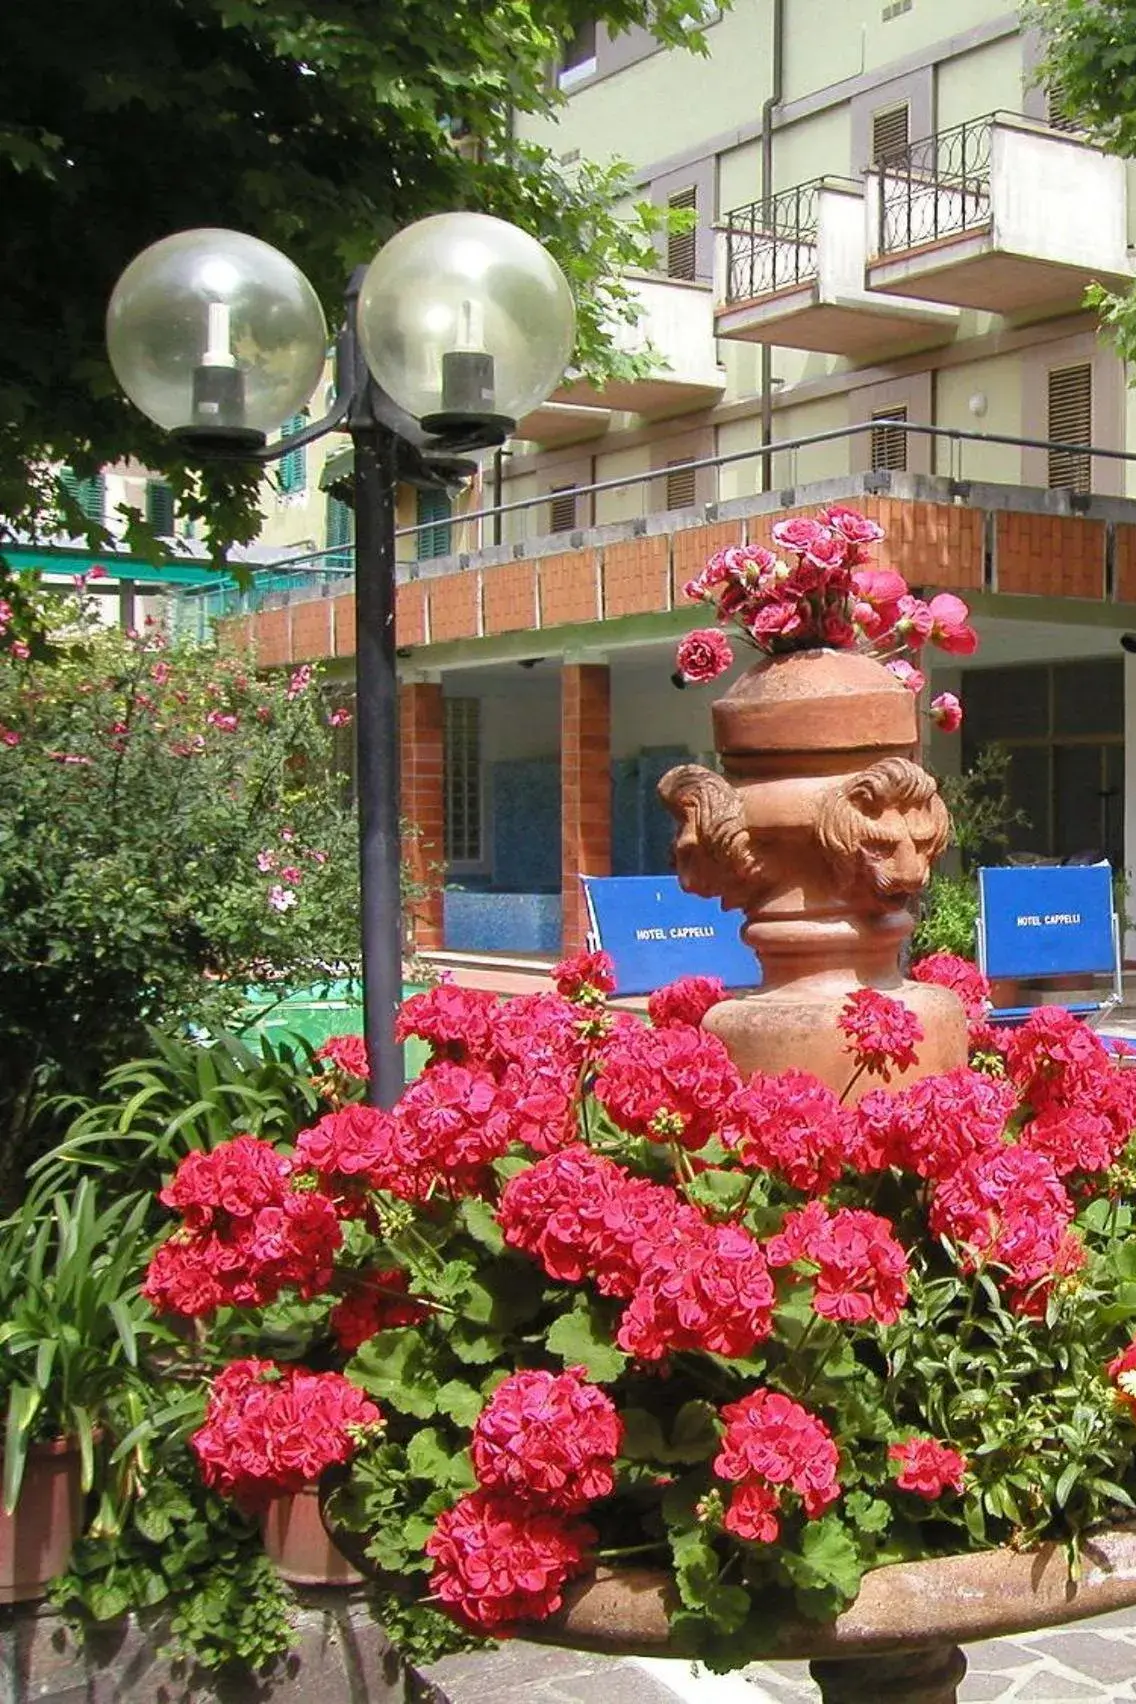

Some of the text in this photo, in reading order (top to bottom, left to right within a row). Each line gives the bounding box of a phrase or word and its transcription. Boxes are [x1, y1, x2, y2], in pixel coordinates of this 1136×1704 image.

[1017, 913, 1081, 927] HOTEL CAPPELLI
[636, 926, 714, 940] HOTEL CAPPELLI
